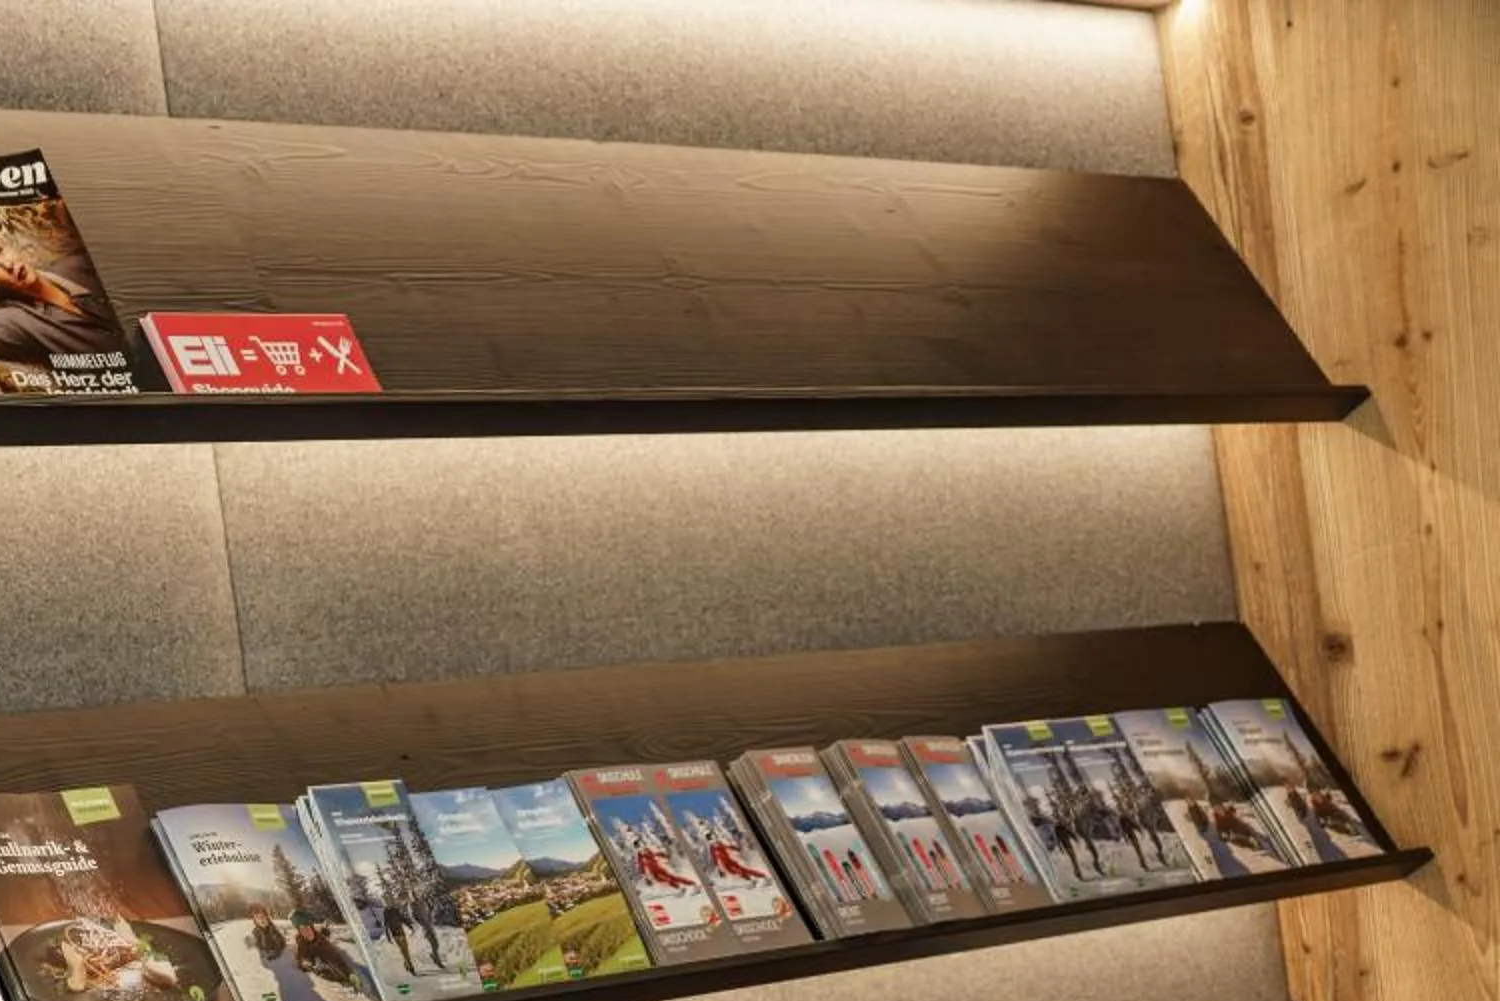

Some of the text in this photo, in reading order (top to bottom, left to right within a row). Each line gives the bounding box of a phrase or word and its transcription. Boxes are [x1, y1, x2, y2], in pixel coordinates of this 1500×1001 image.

[49, 351, 127, 369] HUMMELFLUG
[11, 370, 134, 387] Das Herz der
[73, 839, 89, 855] &
